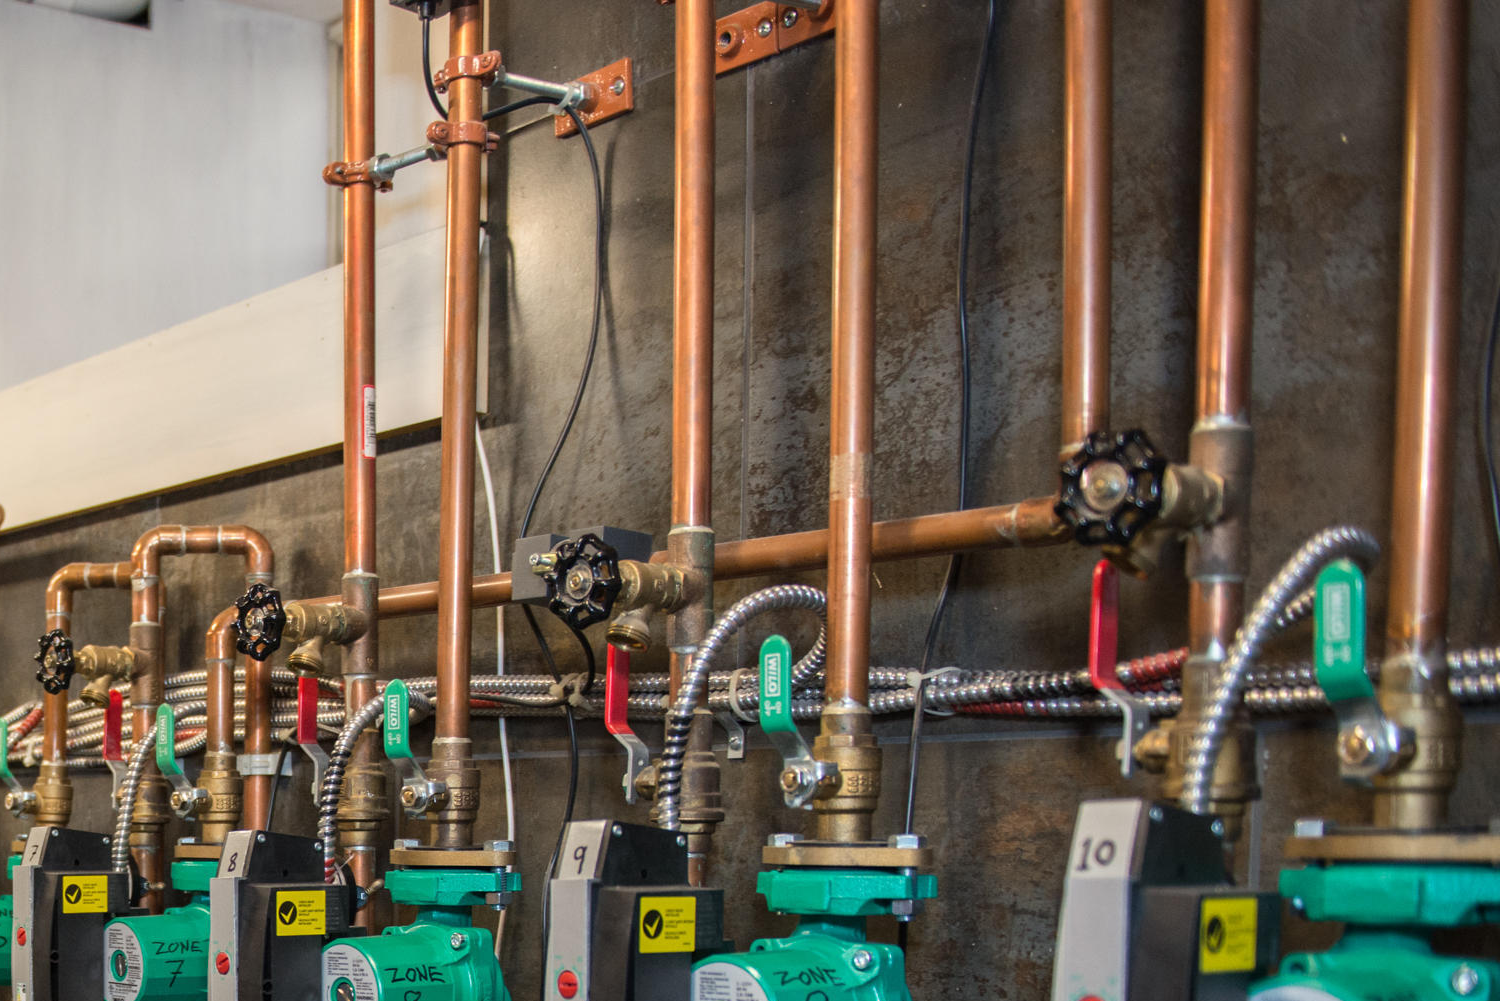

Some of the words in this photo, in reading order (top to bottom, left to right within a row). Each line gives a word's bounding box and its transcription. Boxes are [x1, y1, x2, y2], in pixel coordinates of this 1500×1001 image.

[768, 658, 777, 693] WILO
[390, 698, 398, 726] WILO
[28, 845, 39, 861] 7
[227, 852, 238, 872] 8
[574, 845, 587, 874] 9
[1076, 836, 1116, 871] 10
[152, 939, 204, 955] ZONE
[164, 959, 185, 988] 7
[384, 964, 446, 984] ZONE
[773, 966, 845, 987] ZONE
